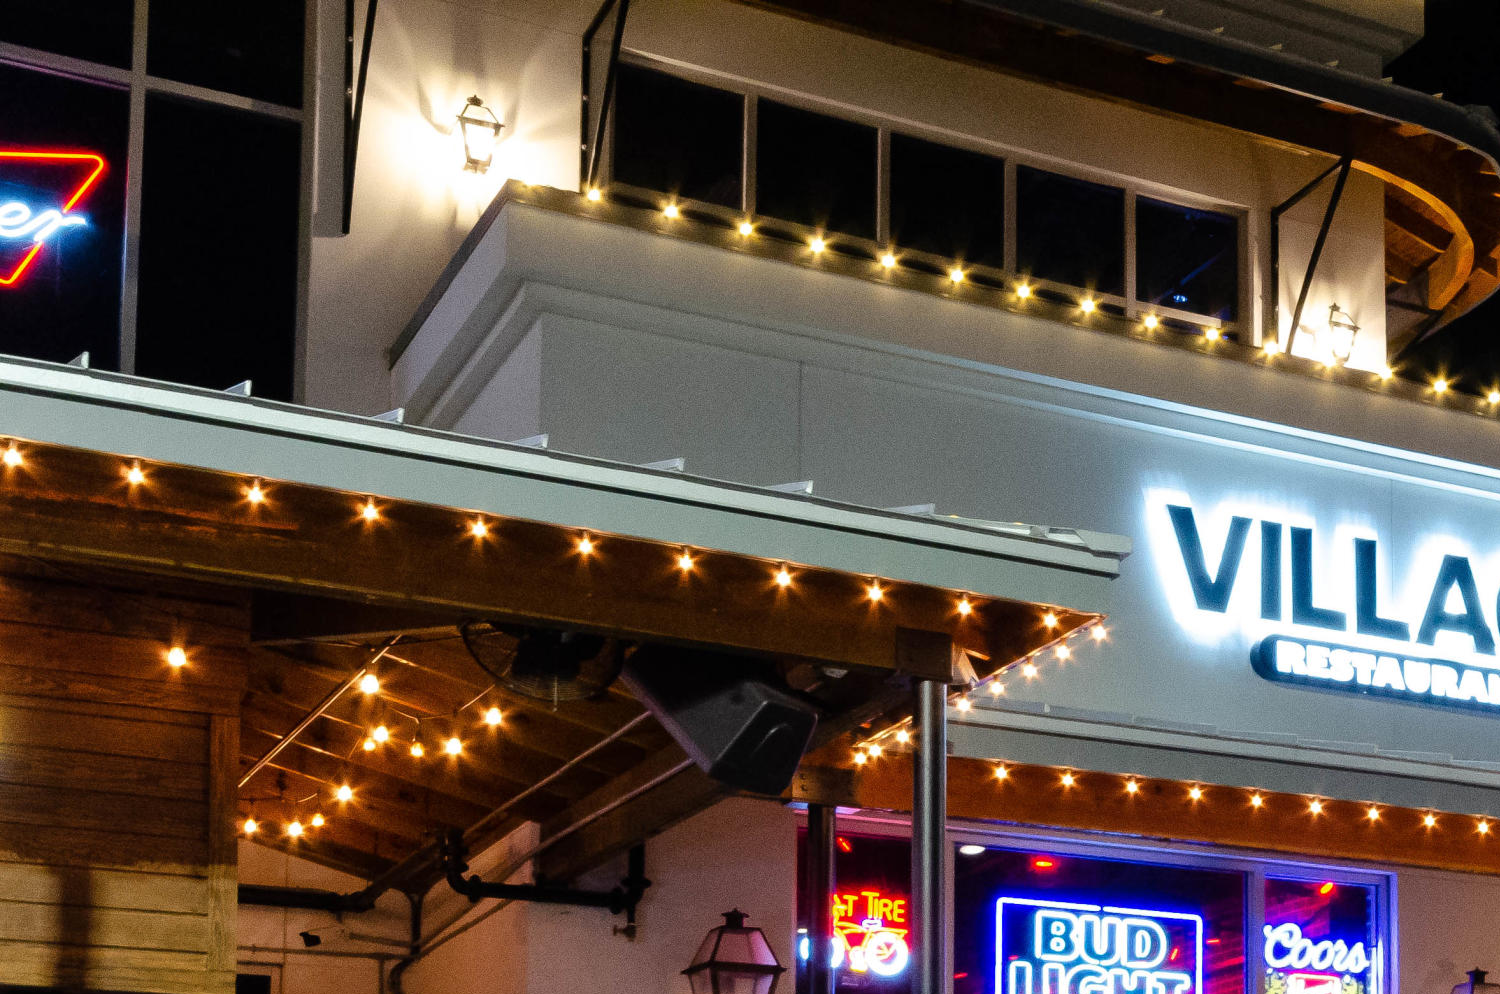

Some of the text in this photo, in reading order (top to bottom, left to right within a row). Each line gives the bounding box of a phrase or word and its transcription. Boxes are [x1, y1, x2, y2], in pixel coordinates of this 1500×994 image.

[861, 891, 906, 922] TIRE
[1035, 909, 1168, 968] BUD
[1263, 923, 1370, 973] Coors
